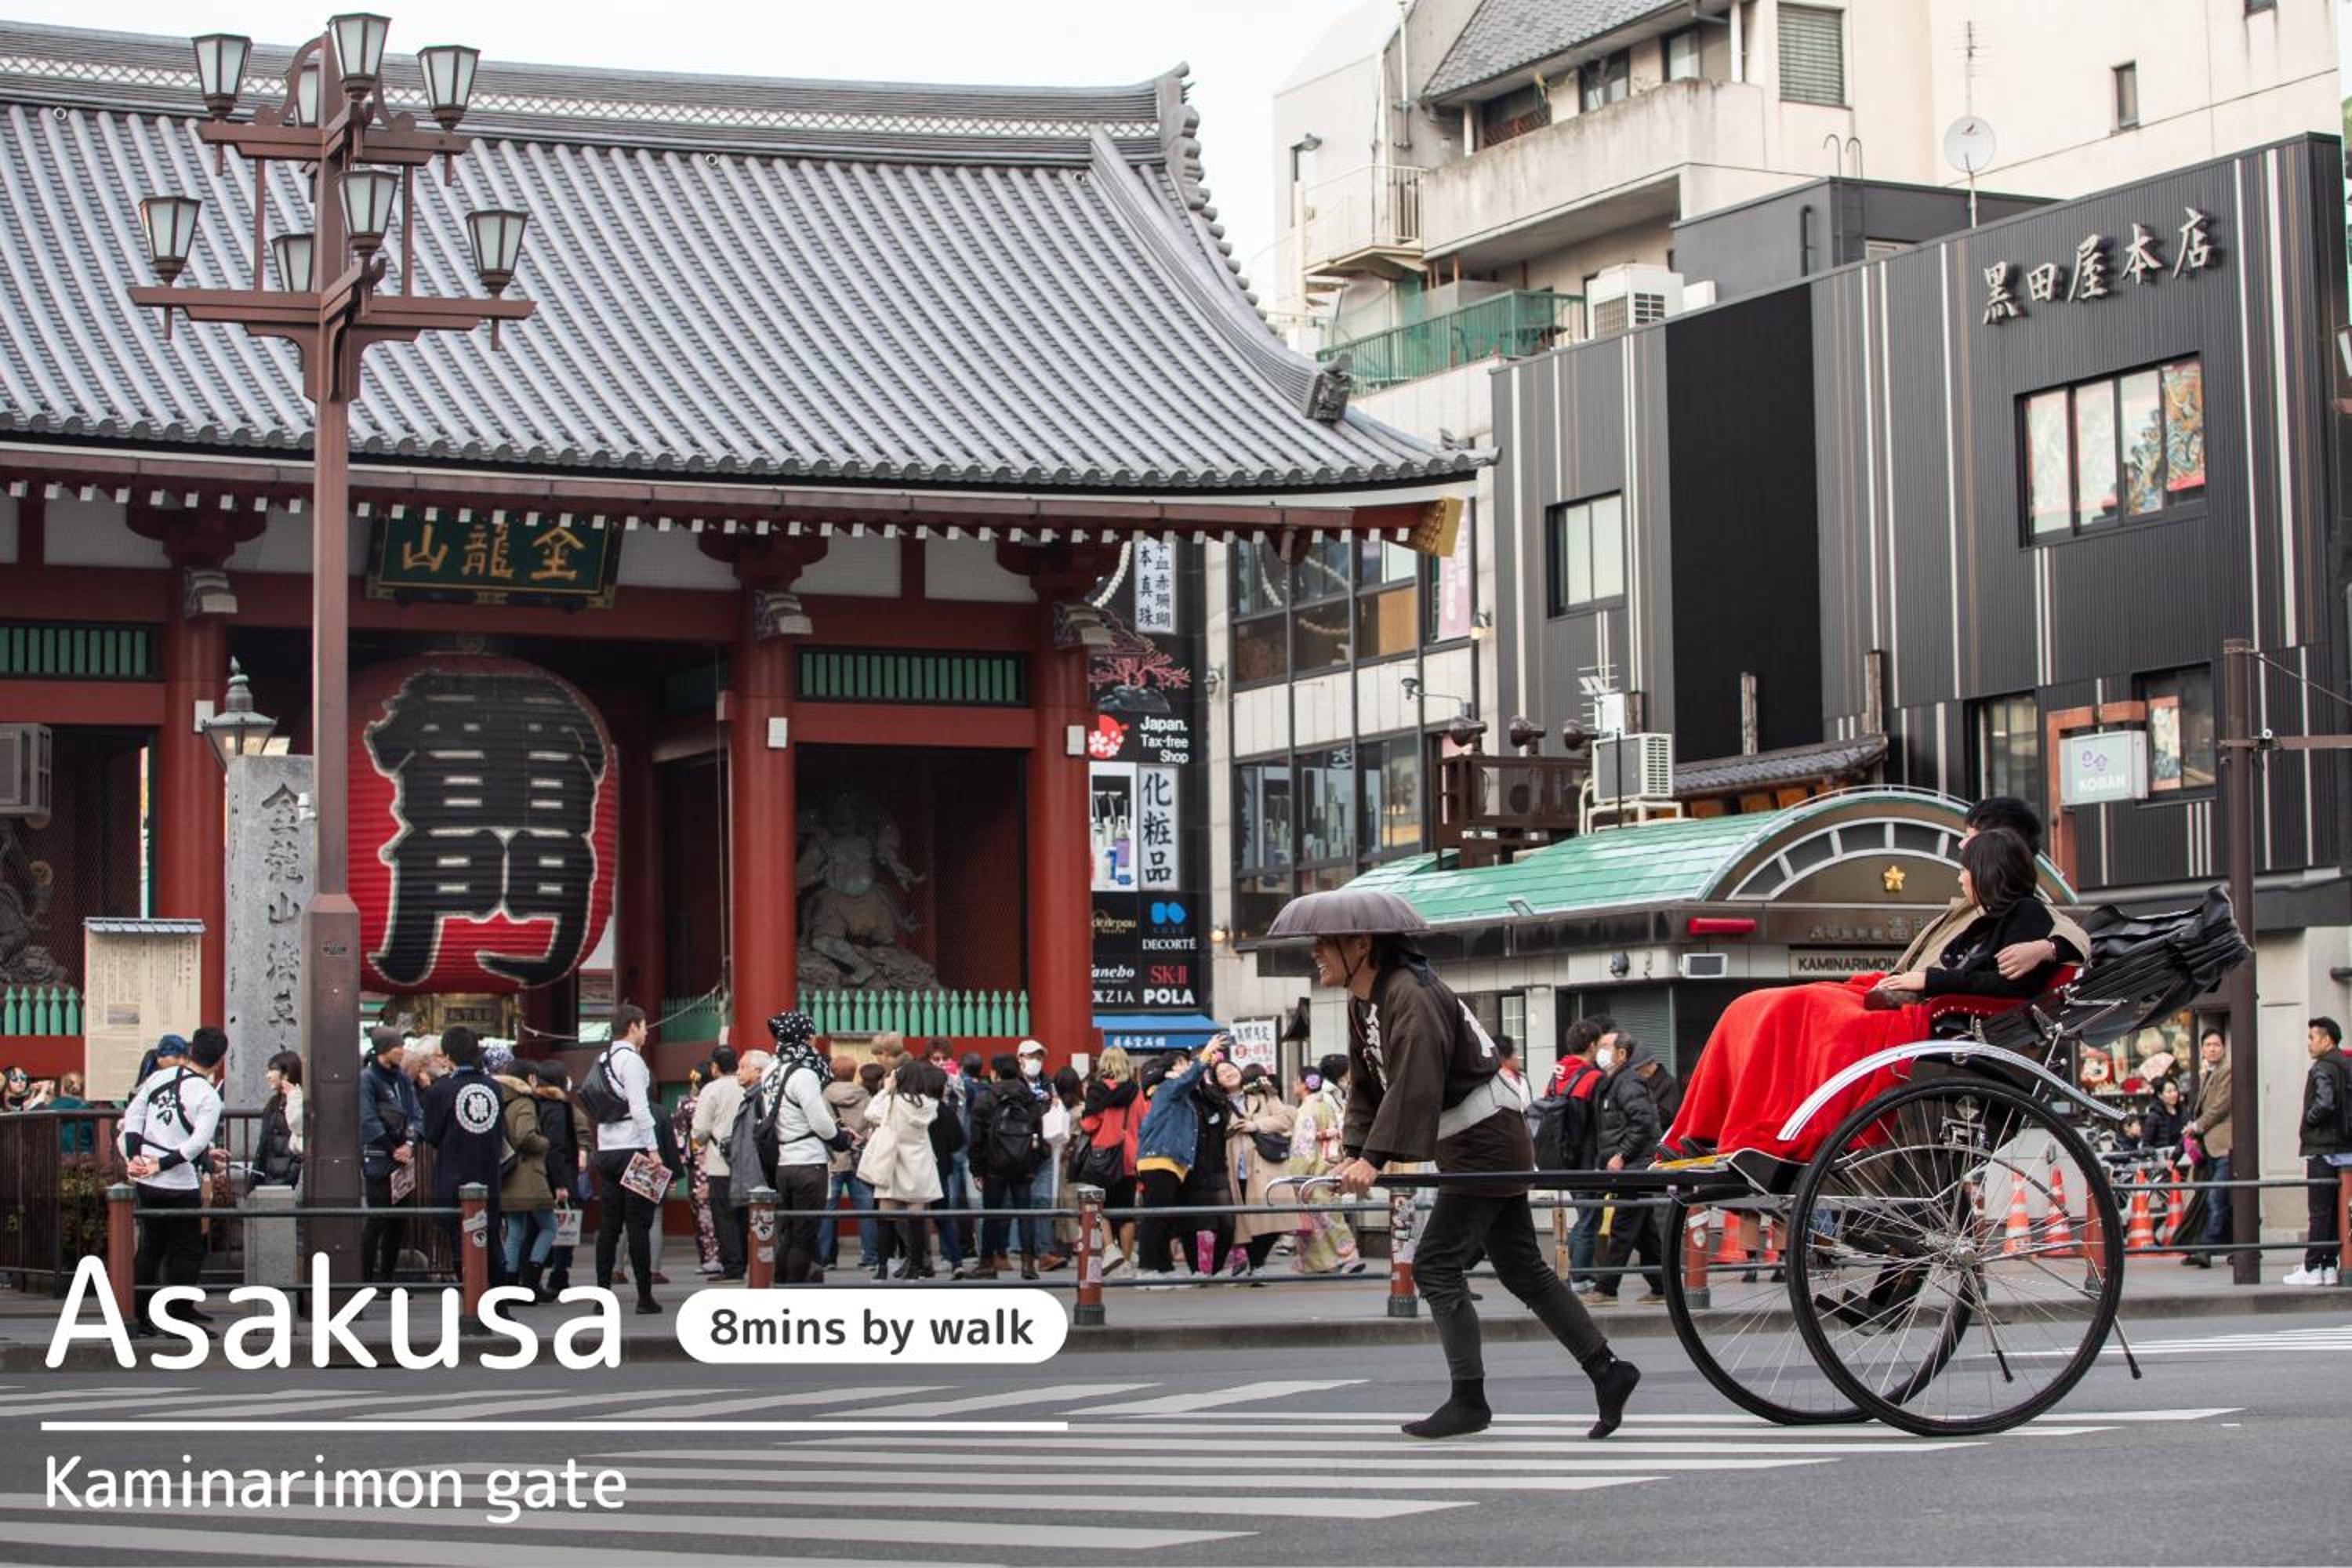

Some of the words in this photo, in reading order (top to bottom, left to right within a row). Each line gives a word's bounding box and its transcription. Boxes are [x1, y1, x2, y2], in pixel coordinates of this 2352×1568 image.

[1983, 208, 2215, 325] 黒田屋本店
[1139, 546, 1154, 626] 本真珠
[1140, 717, 1188, 732] Japan.
[1141, 735, 1189, 748] Tax-free
[1160, 750, 1189, 764] Shop
[364, 668, 608, 988] 雷門
[1143, 772, 1173, 884] 化粧品
[1091, 964, 1135, 978] anebo
[1798, 957, 1896, 971] KAMINARIMON
[1144, 989, 1196, 1004] POLA
